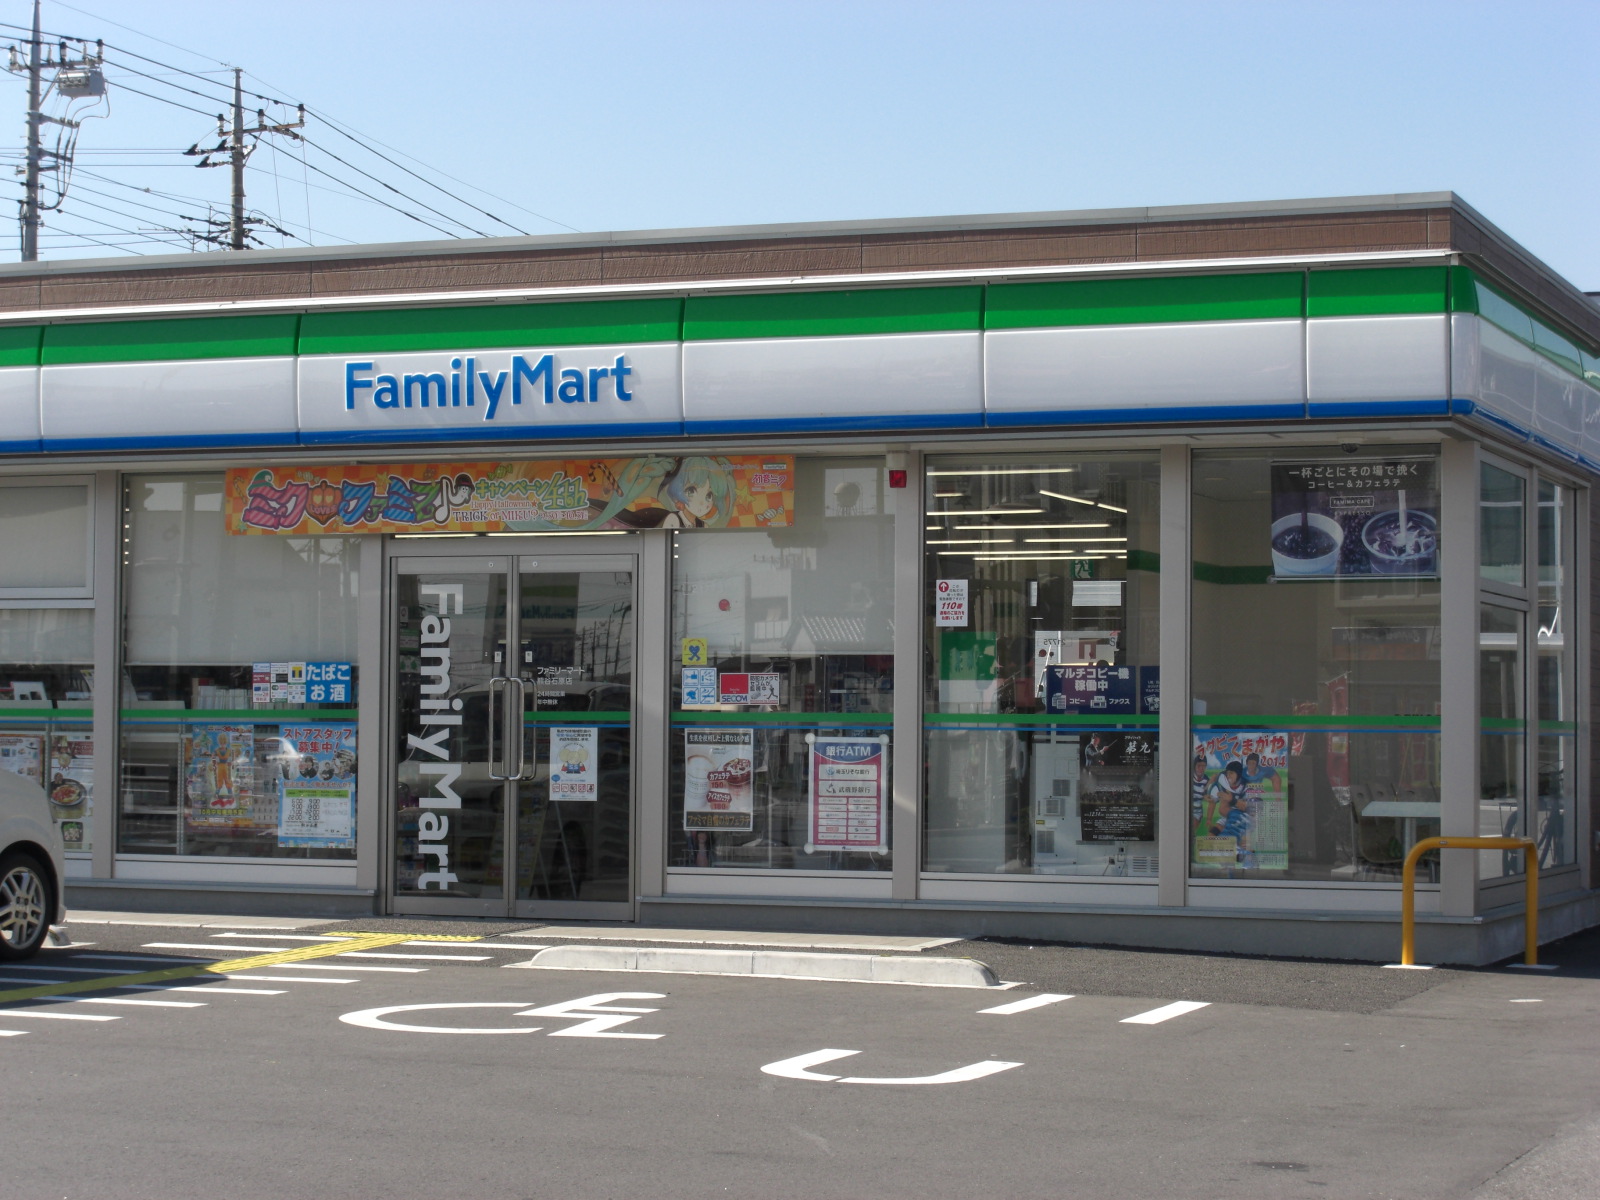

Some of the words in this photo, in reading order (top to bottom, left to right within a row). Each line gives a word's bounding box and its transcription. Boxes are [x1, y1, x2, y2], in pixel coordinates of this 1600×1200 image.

[345, 352, 633, 421] FamilyMart
[1288, 464, 1418, 479] 一杯ごとにその場で挽く
[475, 479, 550, 499] キャンペーン
[453, 510, 488, 522] TRICK
[307, 664, 350, 681] たばこ
[537, 667, 585, 675] ファミリーマート
[1054, 667, 1130, 680] マルチコピー機
[1074, 680, 1109, 692] 稼働中
[311, 684, 346, 702] お酒
[721, 694, 748, 703] SECOM
[283, 728, 353, 741] ストアスタッフ
[407, 583, 464, 891] FamilyMart
[825, 745, 872, 757] 銀行ATM
[1231, 736, 1285, 758] くまがや
[1261, 756, 1286, 767] 2014
